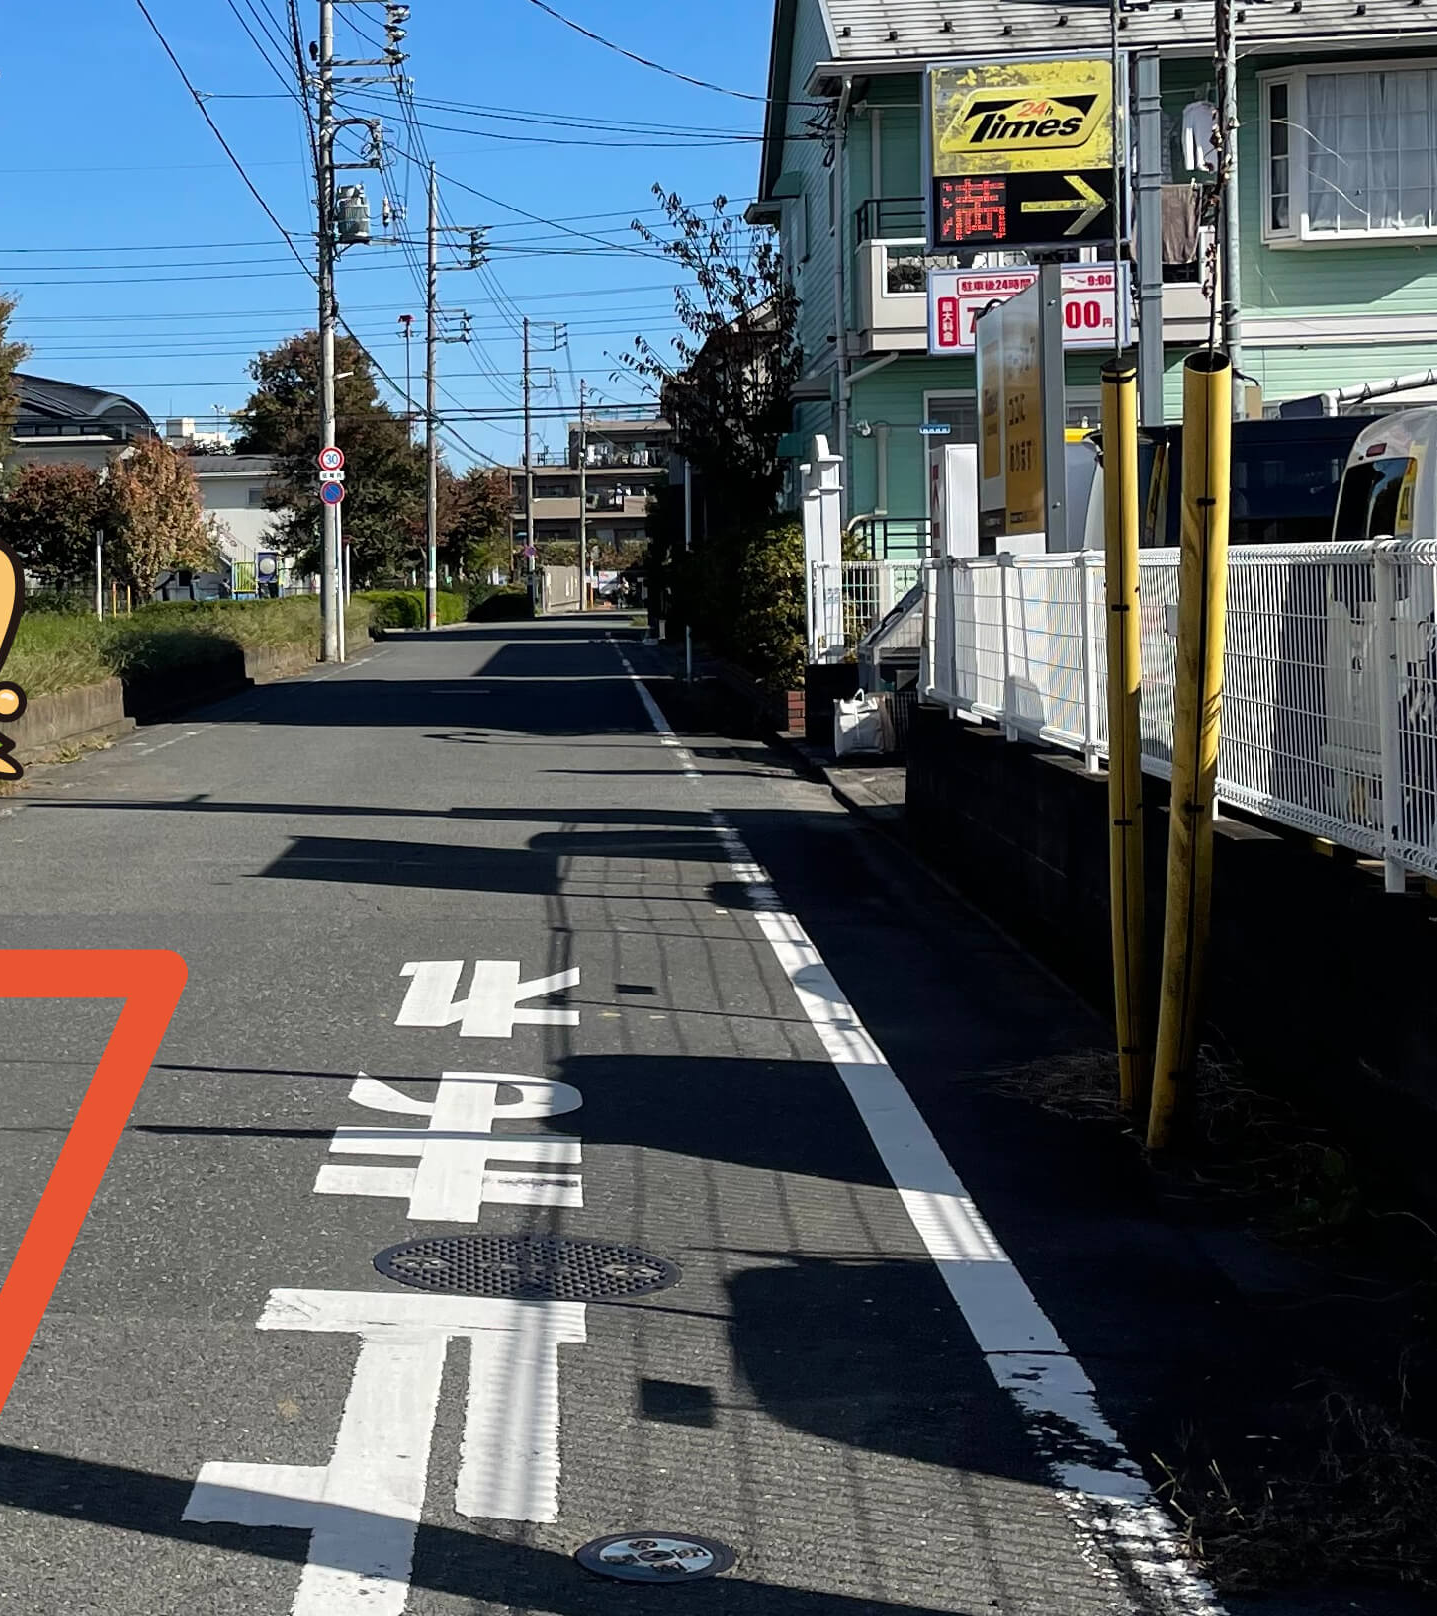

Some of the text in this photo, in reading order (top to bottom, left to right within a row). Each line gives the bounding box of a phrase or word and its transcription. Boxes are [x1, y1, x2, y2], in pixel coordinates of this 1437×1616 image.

[964, 95, 1098, 143] Times
[1018, 100, 1053, 117] 24h
[942, 178, 1006, 241] 満
[325, 453, 338, 465] 30
